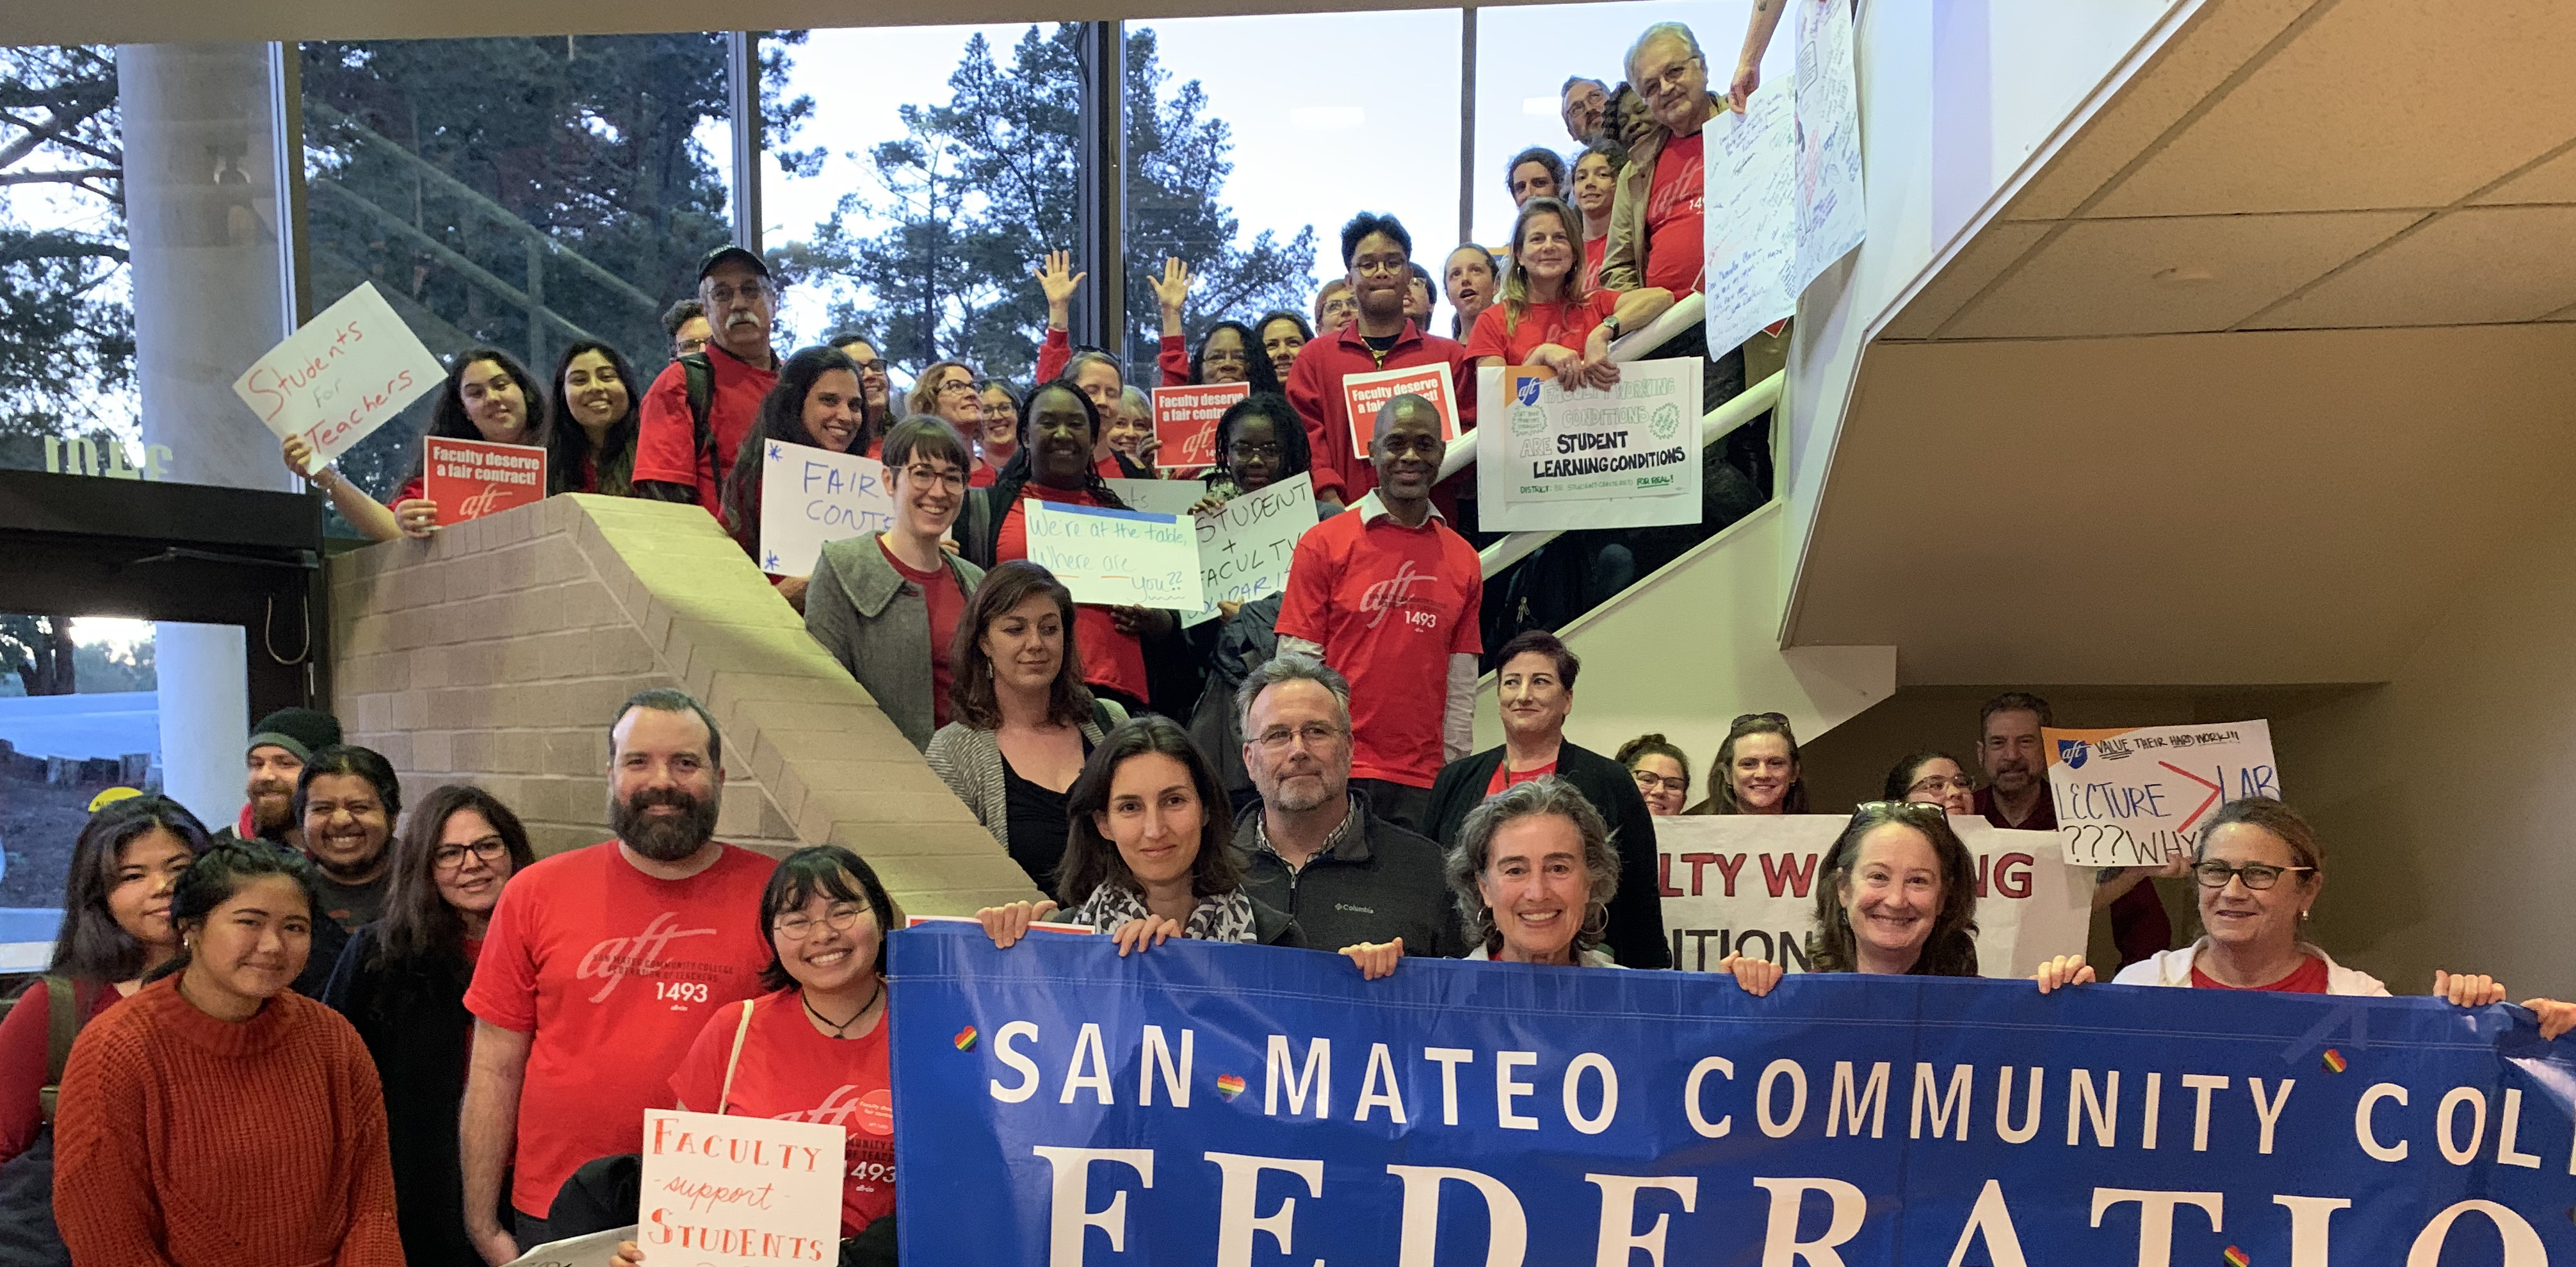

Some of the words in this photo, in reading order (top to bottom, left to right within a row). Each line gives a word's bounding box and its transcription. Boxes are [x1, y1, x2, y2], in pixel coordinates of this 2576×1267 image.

[248, 321, 363, 421] Students
[1159, 394, 1199, 408] Faculty
[1201, 393, 1244, 406] deserve
[1352, 386, 1392, 402] Faculty
[1393, 378, 1439, 396] deserve
[1518, 377, 1544, 403] aft
[1615, 377, 1675, 400] WORKING
[304, 370, 413, 455] Teachers
[1163, 411, 1170, 421] a
[1171, 409, 1191, 421] fair
[1357, 402, 1365, 414] a
[1562, 405, 1649, 428] CONDITIONS
[1519, 437, 1552, 457] ARE
[1557, 430, 1628, 454] STUDENT
[433, 446, 483, 466] Faculty
[485, 452, 540, 470] deserve
[1533, 457, 1608, 479] LEARNING
[1609, 446, 1685, 473] CONDITIONS
[437, 464, 446, 477] a
[448, 464, 473, 479] fair
[474, 468, 537, 486] contract!
[804, 461, 879, 498] FAIR
[1637, 477, 1649, 486] FOR
[1195, 482, 1307, 543] STUDENT
[1029, 514, 1081, 539] We're
[1090, 521, 1106, 538] at
[1114, 523, 1139, 539] the
[1145, 523, 1187, 546] table,
[1032, 545, 1094, 570] Where
[1103, 555, 1137, 572] are
[1405, 610, 1437, 628] 1493
[2062, 740, 2091, 764] aft
[2095, 738, 2131, 754] VALUE
[2133, 737, 2168, 749] THEIR
[2169, 733, 2196, 748] HARD
[2055, 781, 2171, 821] LECTURE
[576, 911, 718, 1004] aft
[656, 981, 708, 1003] 1493
[989, 1020, 1194, 1109] SAN
[1263, 1033, 1619, 1135] MATEO
[1684, 1056, 2296, 1154] COMMUNITY
[2354, 1082, 2576, 1176] COL
[652, 1118, 822, 1172] FACULTY
[647, 1208, 824, 1262] STUDENTS
